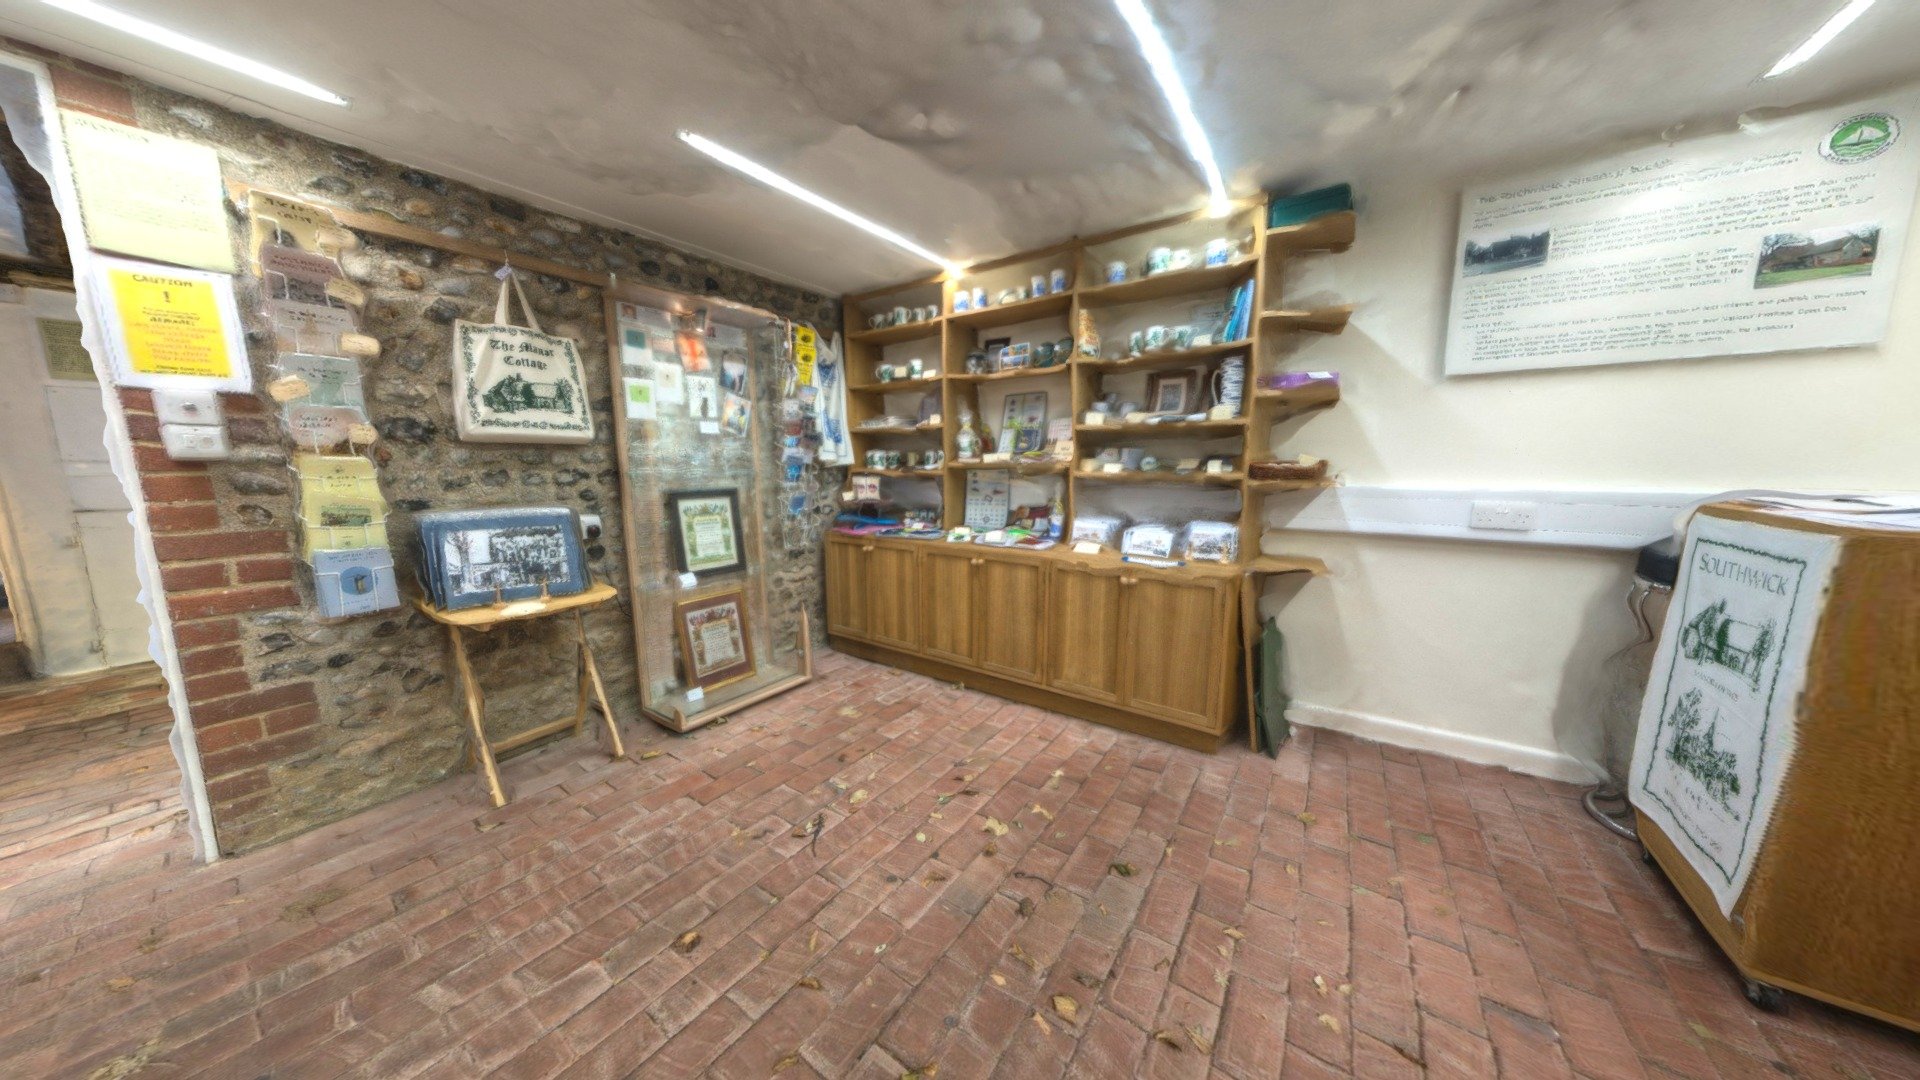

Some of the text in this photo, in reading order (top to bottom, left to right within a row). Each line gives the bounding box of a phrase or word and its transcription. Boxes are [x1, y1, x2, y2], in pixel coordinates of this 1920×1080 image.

[489, 339, 555, 357] The Manor
[503, 355, 548, 371] Cottage
[1699, 552, 1789, 596] SOUTHWICK
